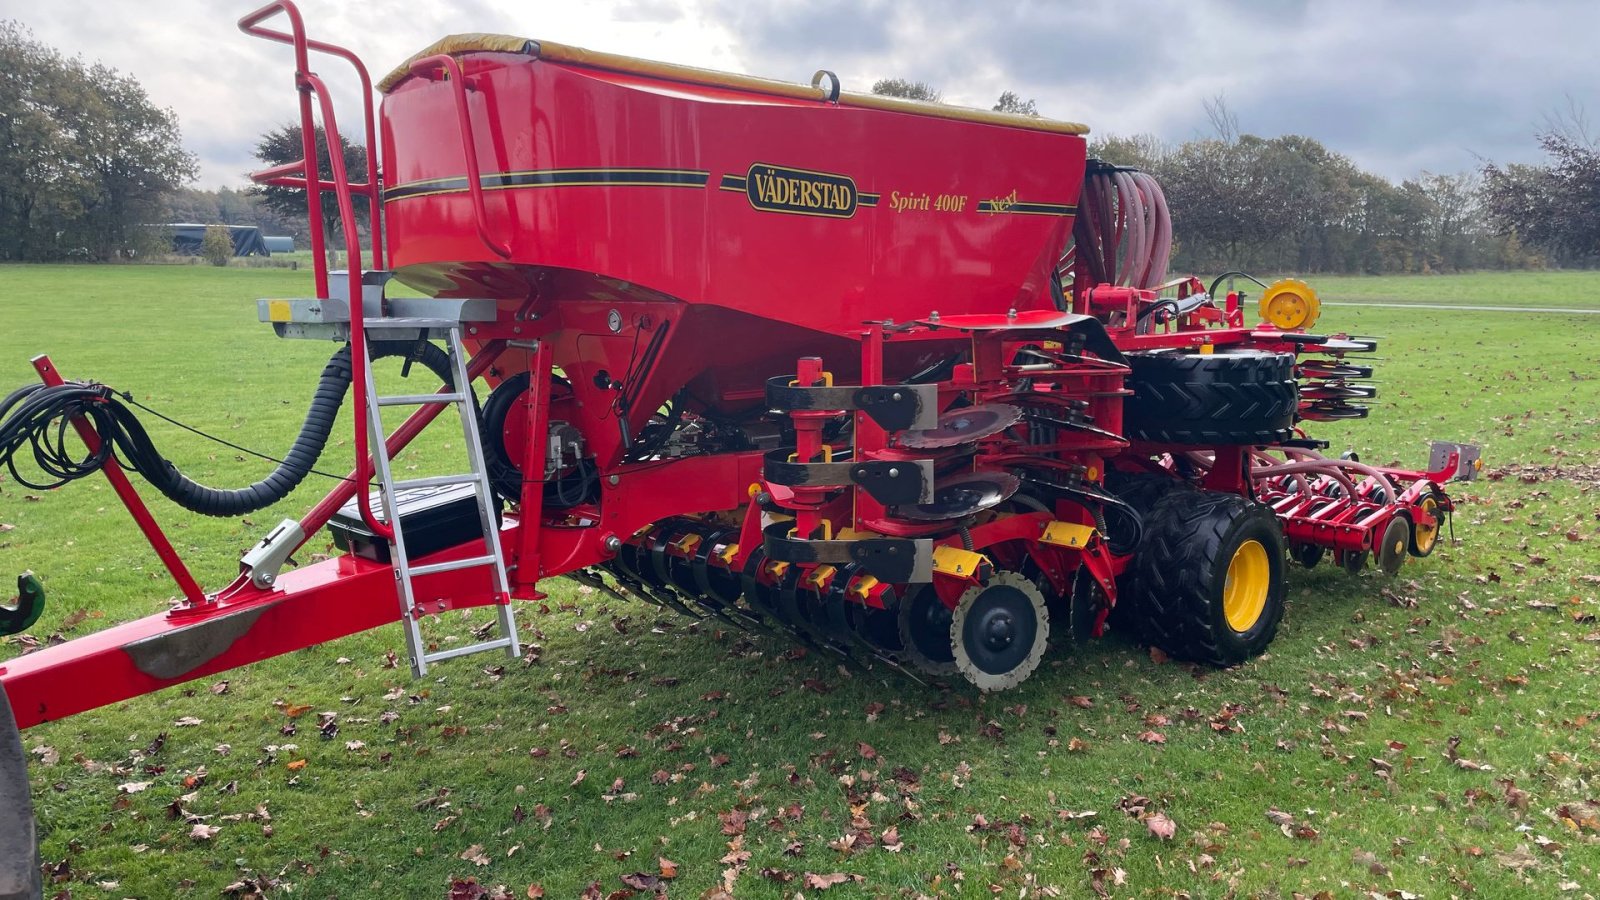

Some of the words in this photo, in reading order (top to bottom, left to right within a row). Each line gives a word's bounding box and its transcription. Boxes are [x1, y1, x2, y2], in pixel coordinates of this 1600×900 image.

[755, 169, 851, 210] VÄDERSTAD
[889, 190, 930, 213] Spirit
[934, 194, 968, 212] 400F
